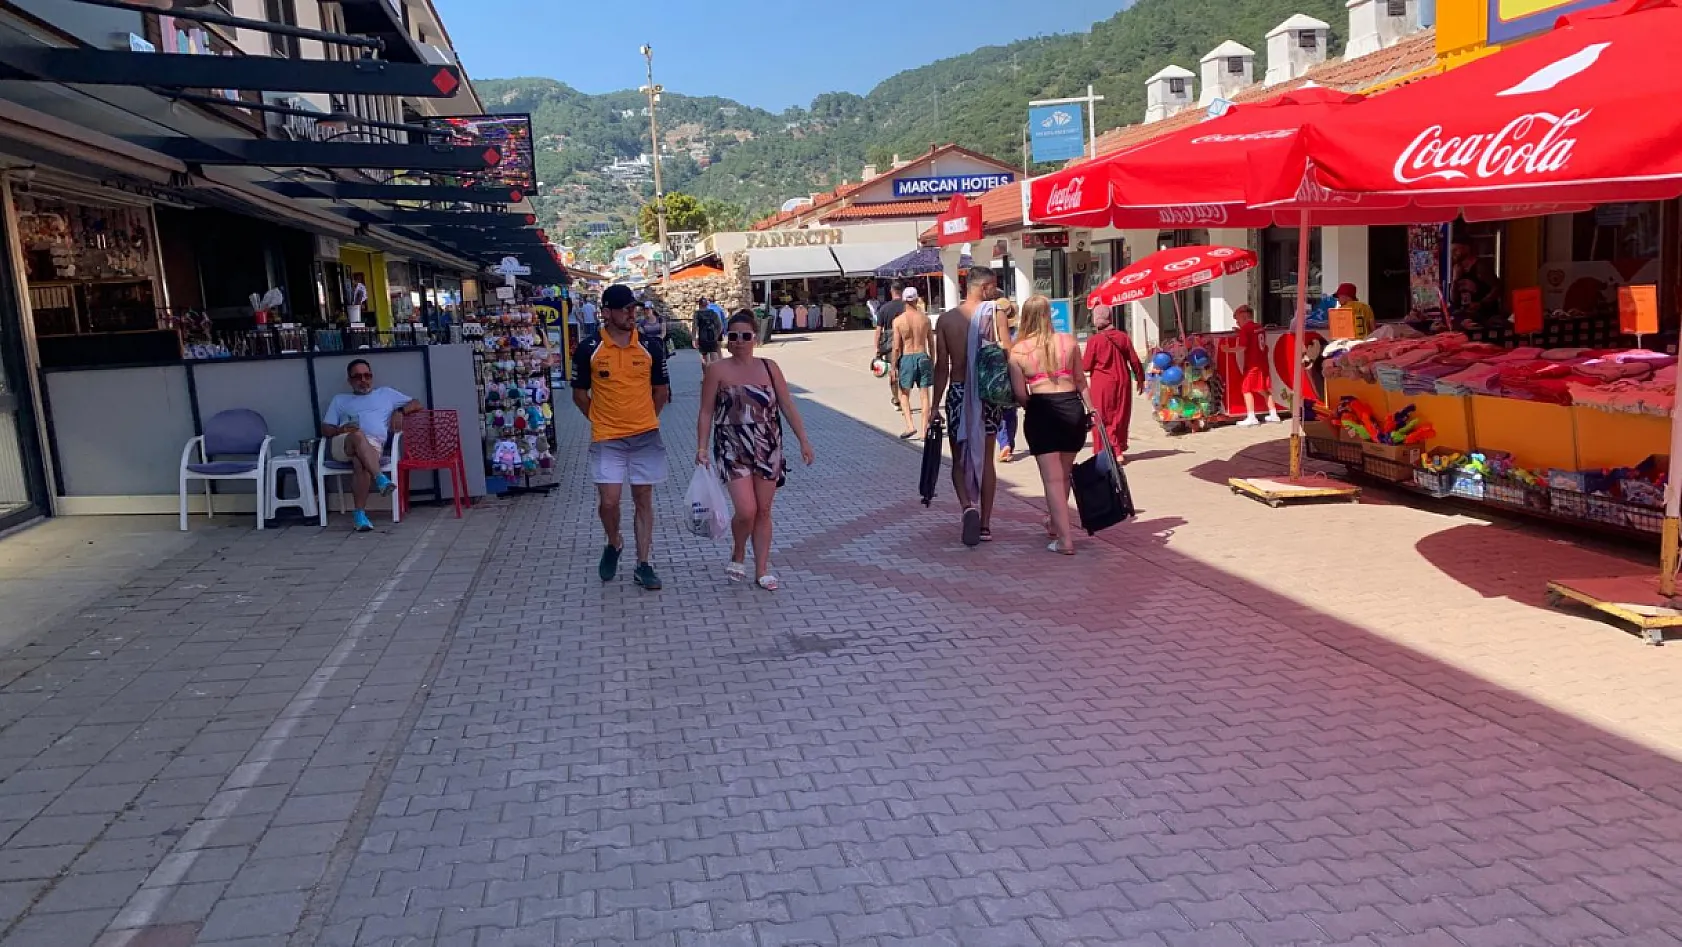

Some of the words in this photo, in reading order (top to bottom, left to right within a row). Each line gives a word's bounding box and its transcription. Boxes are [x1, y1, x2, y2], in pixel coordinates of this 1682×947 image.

[1393, 107, 1594, 183] Coca-Cola
[898, 178, 958, 194] MARCAN
[961, 176, 1008, 191] HOTELS
[1111, 288, 1145, 304] ALGIDA
